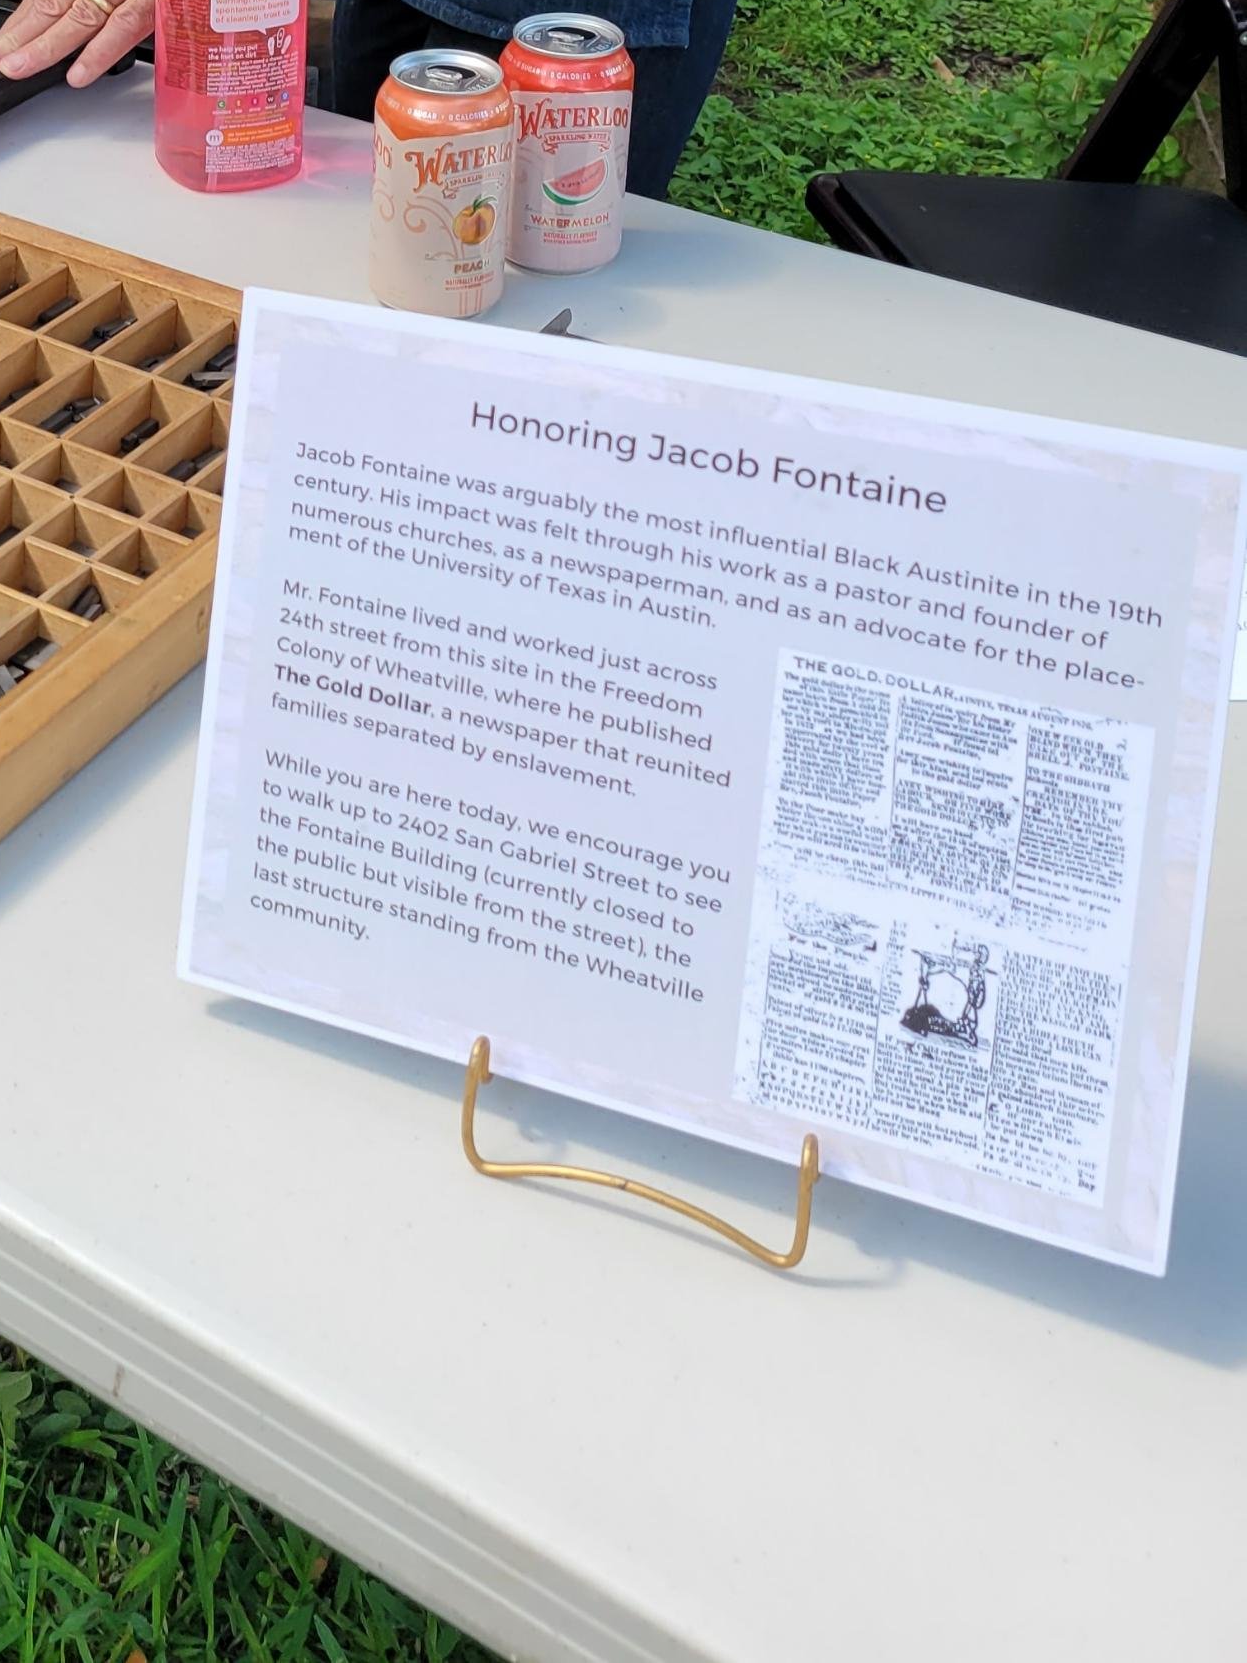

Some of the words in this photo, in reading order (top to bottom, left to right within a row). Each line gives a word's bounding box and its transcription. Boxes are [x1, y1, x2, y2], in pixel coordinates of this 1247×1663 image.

[515, 97, 629, 143] WATERLOO
[454, 258, 490, 275] PEACH
[530, 211, 610, 228] WATERMELON
[470, 400, 637, 463] Honoring
[646, 432, 760, 479] Jacob
[772, 455, 947, 514] Fontaine
[288, 524, 342, 549] ment
[346, 535, 369, 553] of
[372, 539, 406, 561] the
[411, 546, 514, 587] University
[518, 572, 542, 590] of
[545, 575, 606, 604] Texas
[612, 588, 632, 610] in
[637, 595, 718, 628] Austin.
[292, 473, 375, 503] century.
[379, 486, 411, 508] His
[415, 492, 490, 524] impact
[495, 512, 537, 533] was
[543, 518, 578, 542] felt
[584, 527, 673, 562] through
[680, 545, 712, 569] his
[718, 557, 777, 583] work
[782, 571, 808, 588] as
[813, 577, 827, 593] a
[834, 581, 912, 609] pastor
[917, 598, 965, 621] and
[973, 604, 1075, 643] founder
[1080, 629, 1109, 650] of
[295, 440, 355, 468] Jacob
[360, 453, 451, 486] Fontaine
[455, 474, 497, 495] was
[501, 484, 597, 518] arguably
[603, 501, 639, 523] the
[645, 512, 702, 536] most
[709, 519, 827, 561] influential
[833, 545, 899, 576] Black
[905, 560, 1020, 599] Austinite
[1026, 581, 1049, 606] in
[1058, 590, 1101, 615] the
[1107, 598, 1162, 628] 19th
[282, 578, 314, 600] Mr.
[317, 585, 407, 621] Fontaine
[411, 605, 461, 633] lived
[465, 622, 507, 643] and
[512, 632, 594, 663] worked
[596, 646, 641, 674] just
[645, 662, 717, 690] across
[290, 501, 393, 534] numerous
[397, 520, 499, 557] churches,
[502, 544, 525, 561] as
[530, 550, 543, 565] a
[549, 554, 730, 605] newspaperman,
[734, 592, 780, 615] and
[785, 603, 811, 621] as
[817, 609, 847, 629] an
[853, 617, 966, 653] advocate
[974, 637, 1009, 662] for
[1014, 647, 1057, 672] the
[1063, 659, 1144, 689] place-
[275, 635, 345, 669] Colony
[349, 653, 372, 671] of
[374, 656, 490, 700] Wheatville,
[493, 687, 561, 716] where
[567, 700, 595, 723] he
[599, 712, 713, 752] published
[278, 606, 324, 632] 24th
[328, 620, 387, 646] street
[392, 631, 441, 659] from
[447, 644, 485, 668] this
[490, 655, 528, 678] site
[534, 662, 554, 684] in
[560, 670, 597, 693] the
[602, 679, 702, 719] Freedom
[792, 655, 827, 674] THE
[271, 690, 348, 725] families
[352, 714, 455, 752] separated
[460, 736, 487, 762] by
[491, 748, 638, 797] enslavement.
[273, 662, 311, 687] The
[314, 673, 363, 700] Gold
[367, 685, 436, 718] Dollar,
[440, 706, 452, 721] a
[458, 710, 578, 750] newspaper
[583, 737, 629, 764] that
[634, 752, 731, 788] reunited
[259, 806, 292, 829] the
[296, 815, 385, 854] Fontaine
[390, 839, 477, 882] Building
[483, 864, 588, 911] (currently
[592, 896, 665, 929] closed
[671, 915, 694, 937] to
[262, 777, 282, 797] to
[286, 786, 334, 811] walk
[339, 800, 367, 822] up
[371, 806, 393, 826] to
[397, 812, 449, 842] 2402
[453, 827, 493, 853] San
[498, 839, 576, 875] Gabriel
[581, 861, 650, 894] Street
[655, 880, 678, 901] to
[683, 891, 722, 913] see
[264, 748, 322, 778] While
[324, 767, 362, 789] you
[367, 778, 400, 798] are
[405, 783, 452, 812] here
[457, 798, 523, 832] today,
[527, 818, 560, 839] we
[564, 829, 684, 872] encourage
[687, 860, 730, 884] you
[249, 894, 371, 941] community.
[252, 860, 288, 887] last
[291, 876, 384, 913] structure
[387, 902, 480, 944] standing
[486, 925, 537, 957] from
[543, 943, 580, 968] the
[585, 953, 704, 1002] Wheatville
[256, 834, 289, 857] the
[293, 846, 357, 876] public
[362, 860, 398, 887] but
[402, 874, 468, 906] visible
[473, 892, 524, 922] from
[530, 908, 567, 933] the
[571, 923, 649, 958] street),
[654, 942, 691, 968] the
